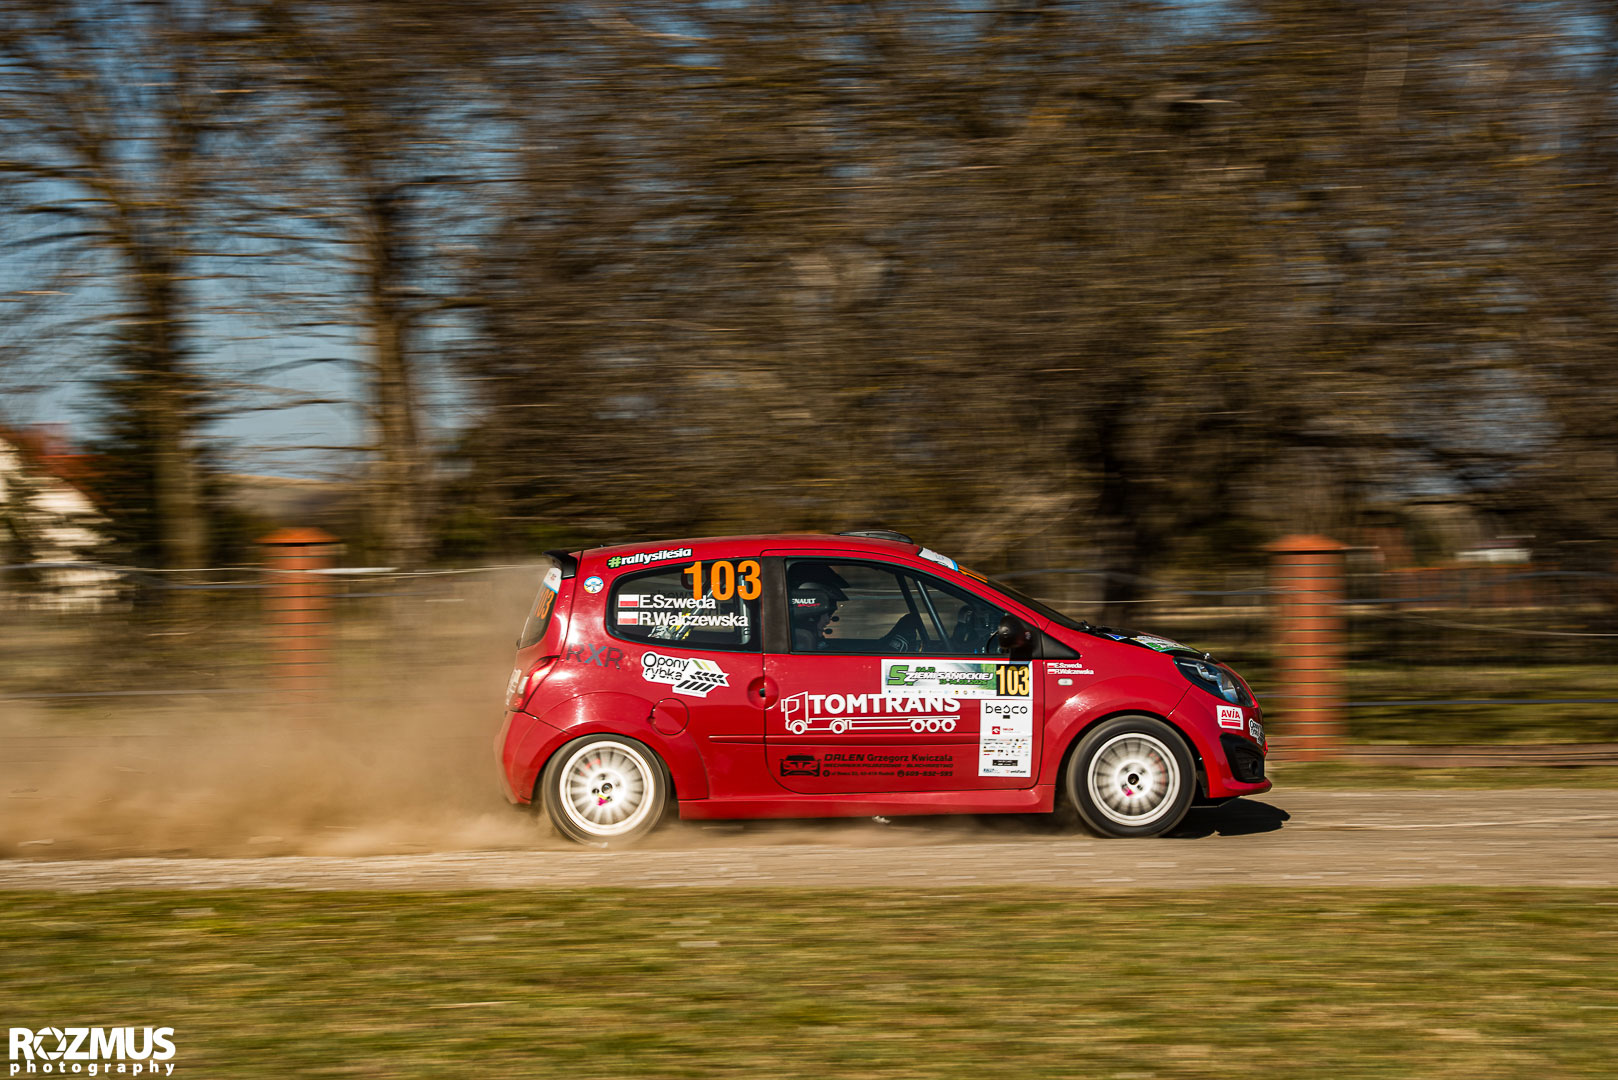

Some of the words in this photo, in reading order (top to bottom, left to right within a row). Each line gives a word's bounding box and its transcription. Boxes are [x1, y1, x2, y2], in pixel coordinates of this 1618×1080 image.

[607, 548, 692, 568] #rallysilesia
[684, 560, 762, 600] 103
[566, 644, 623, 669] RXR
[643, 653, 690, 671] Opony
[936, 672, 993, 681] SANOCKIEJ
[996, 665, 1030, 696] 103
[808, 693, 961, 715] TOMTRANS
[867, 753, 909, 763] Grzegorz
